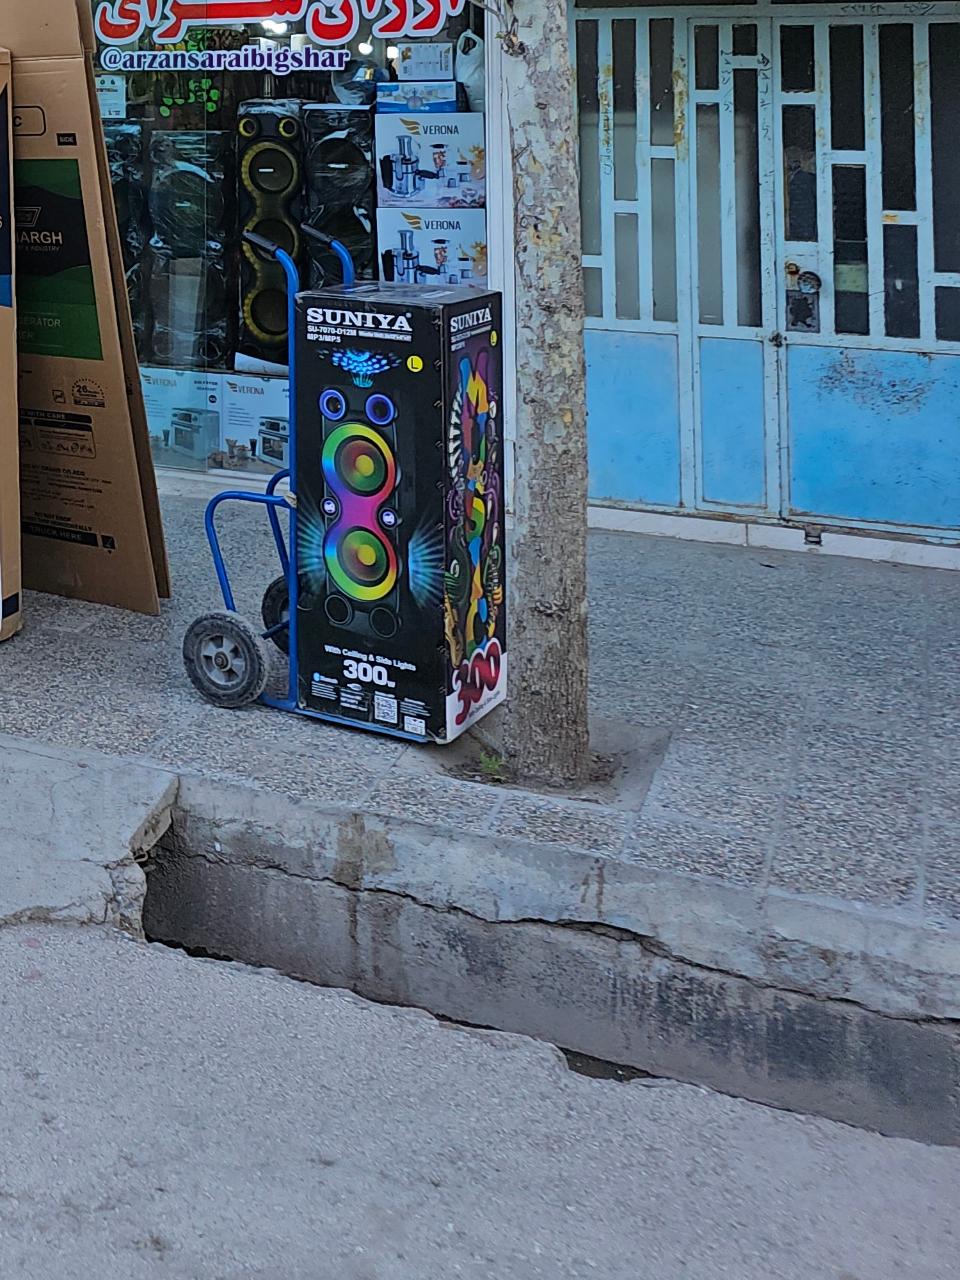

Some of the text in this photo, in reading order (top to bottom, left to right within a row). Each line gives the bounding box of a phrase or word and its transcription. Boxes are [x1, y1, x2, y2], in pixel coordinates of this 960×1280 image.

[100, 45, 351, 76] @arzansaraibigshar
[422, 124, 459, 135] VERONA
[424, 220, 461, 231] VERONA
[306, 308, 413, 332] SUNIYA
[450, 308, 492, 333] SUNIYA
[152, 378, 177, 387] VERONA
[238, 385, 265, 395] VERONA
